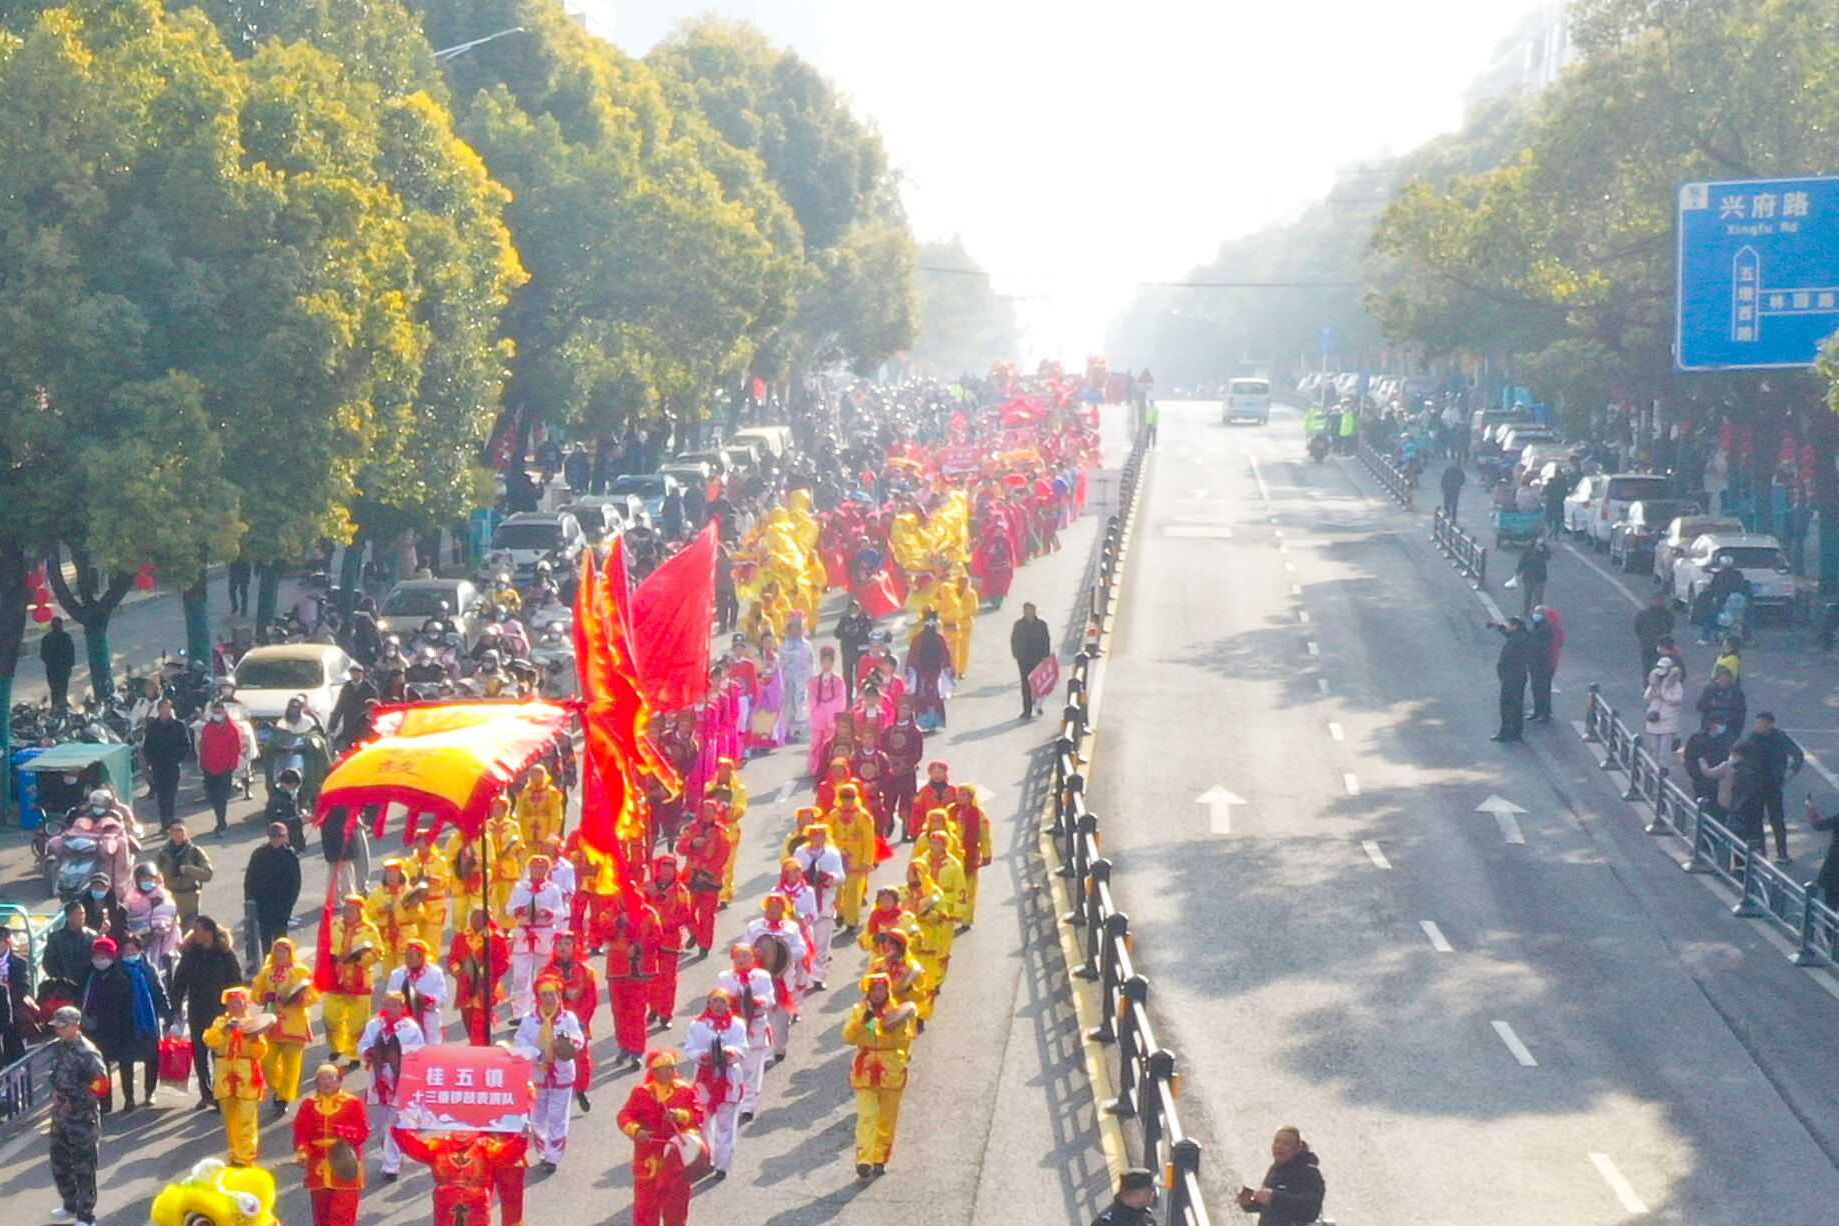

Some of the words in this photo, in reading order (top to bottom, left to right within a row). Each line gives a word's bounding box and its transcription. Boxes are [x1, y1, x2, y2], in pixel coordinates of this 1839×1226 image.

[1720, 191, 1811, 220] 兴府路
[425, 1067, 504, 1088] 桂五镇
